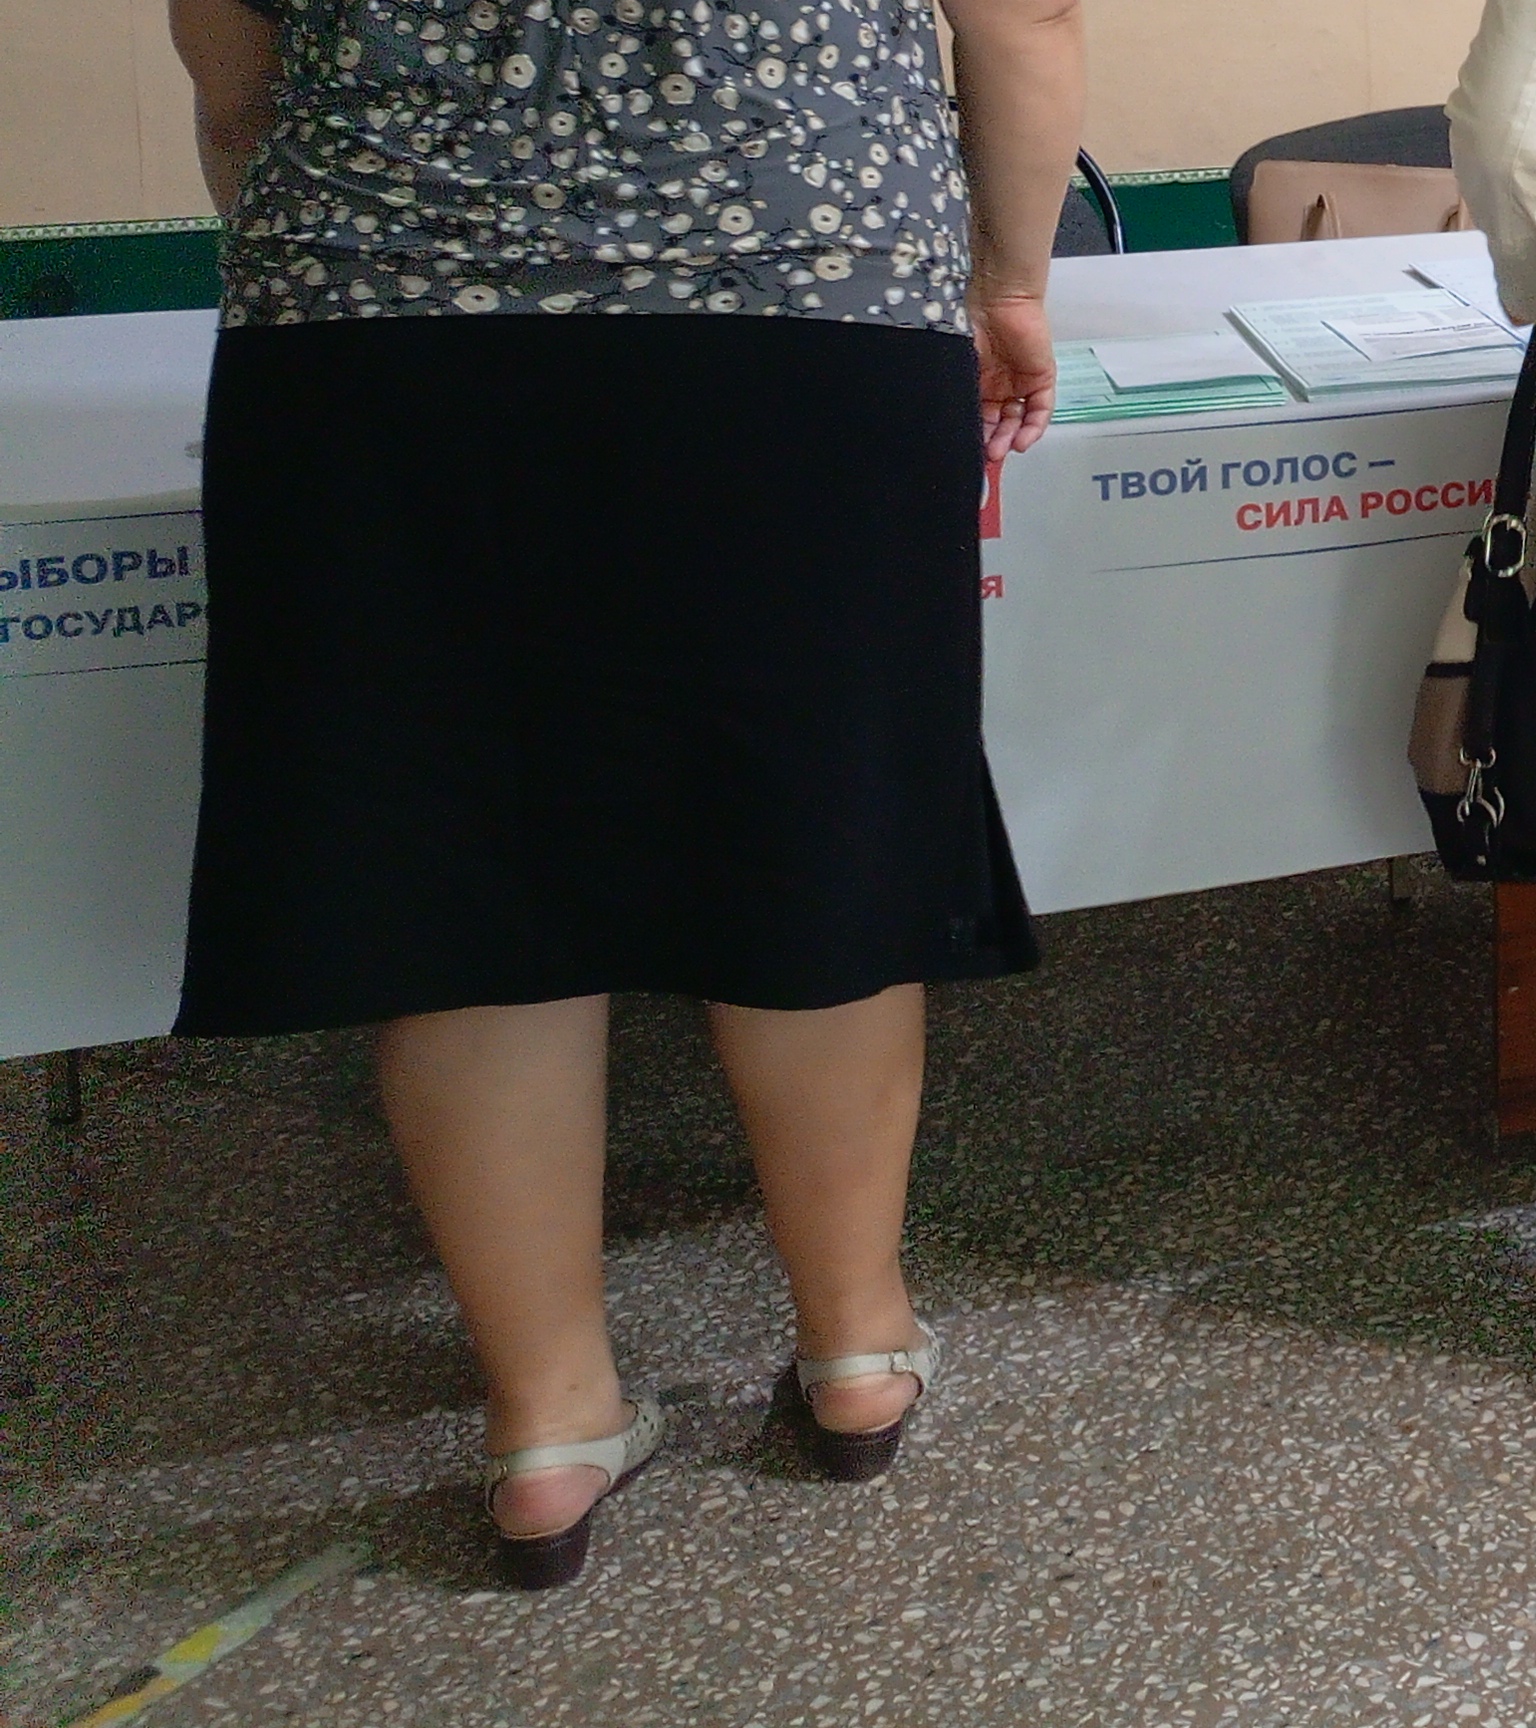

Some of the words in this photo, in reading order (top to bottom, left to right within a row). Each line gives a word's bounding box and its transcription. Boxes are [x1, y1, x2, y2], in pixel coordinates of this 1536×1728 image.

[1093, 458, 1206, 501] ТВОЙ
[1220, 451, 1357, 490] ГОЛОС
[1236, 497, 1349, 530] СИЛА
[1360, 479, 1493, 517] РОССИ
[0, 546, 191, 591] ЫБОРЫ
[0, 602, 202, 643] ГОСУДАР
